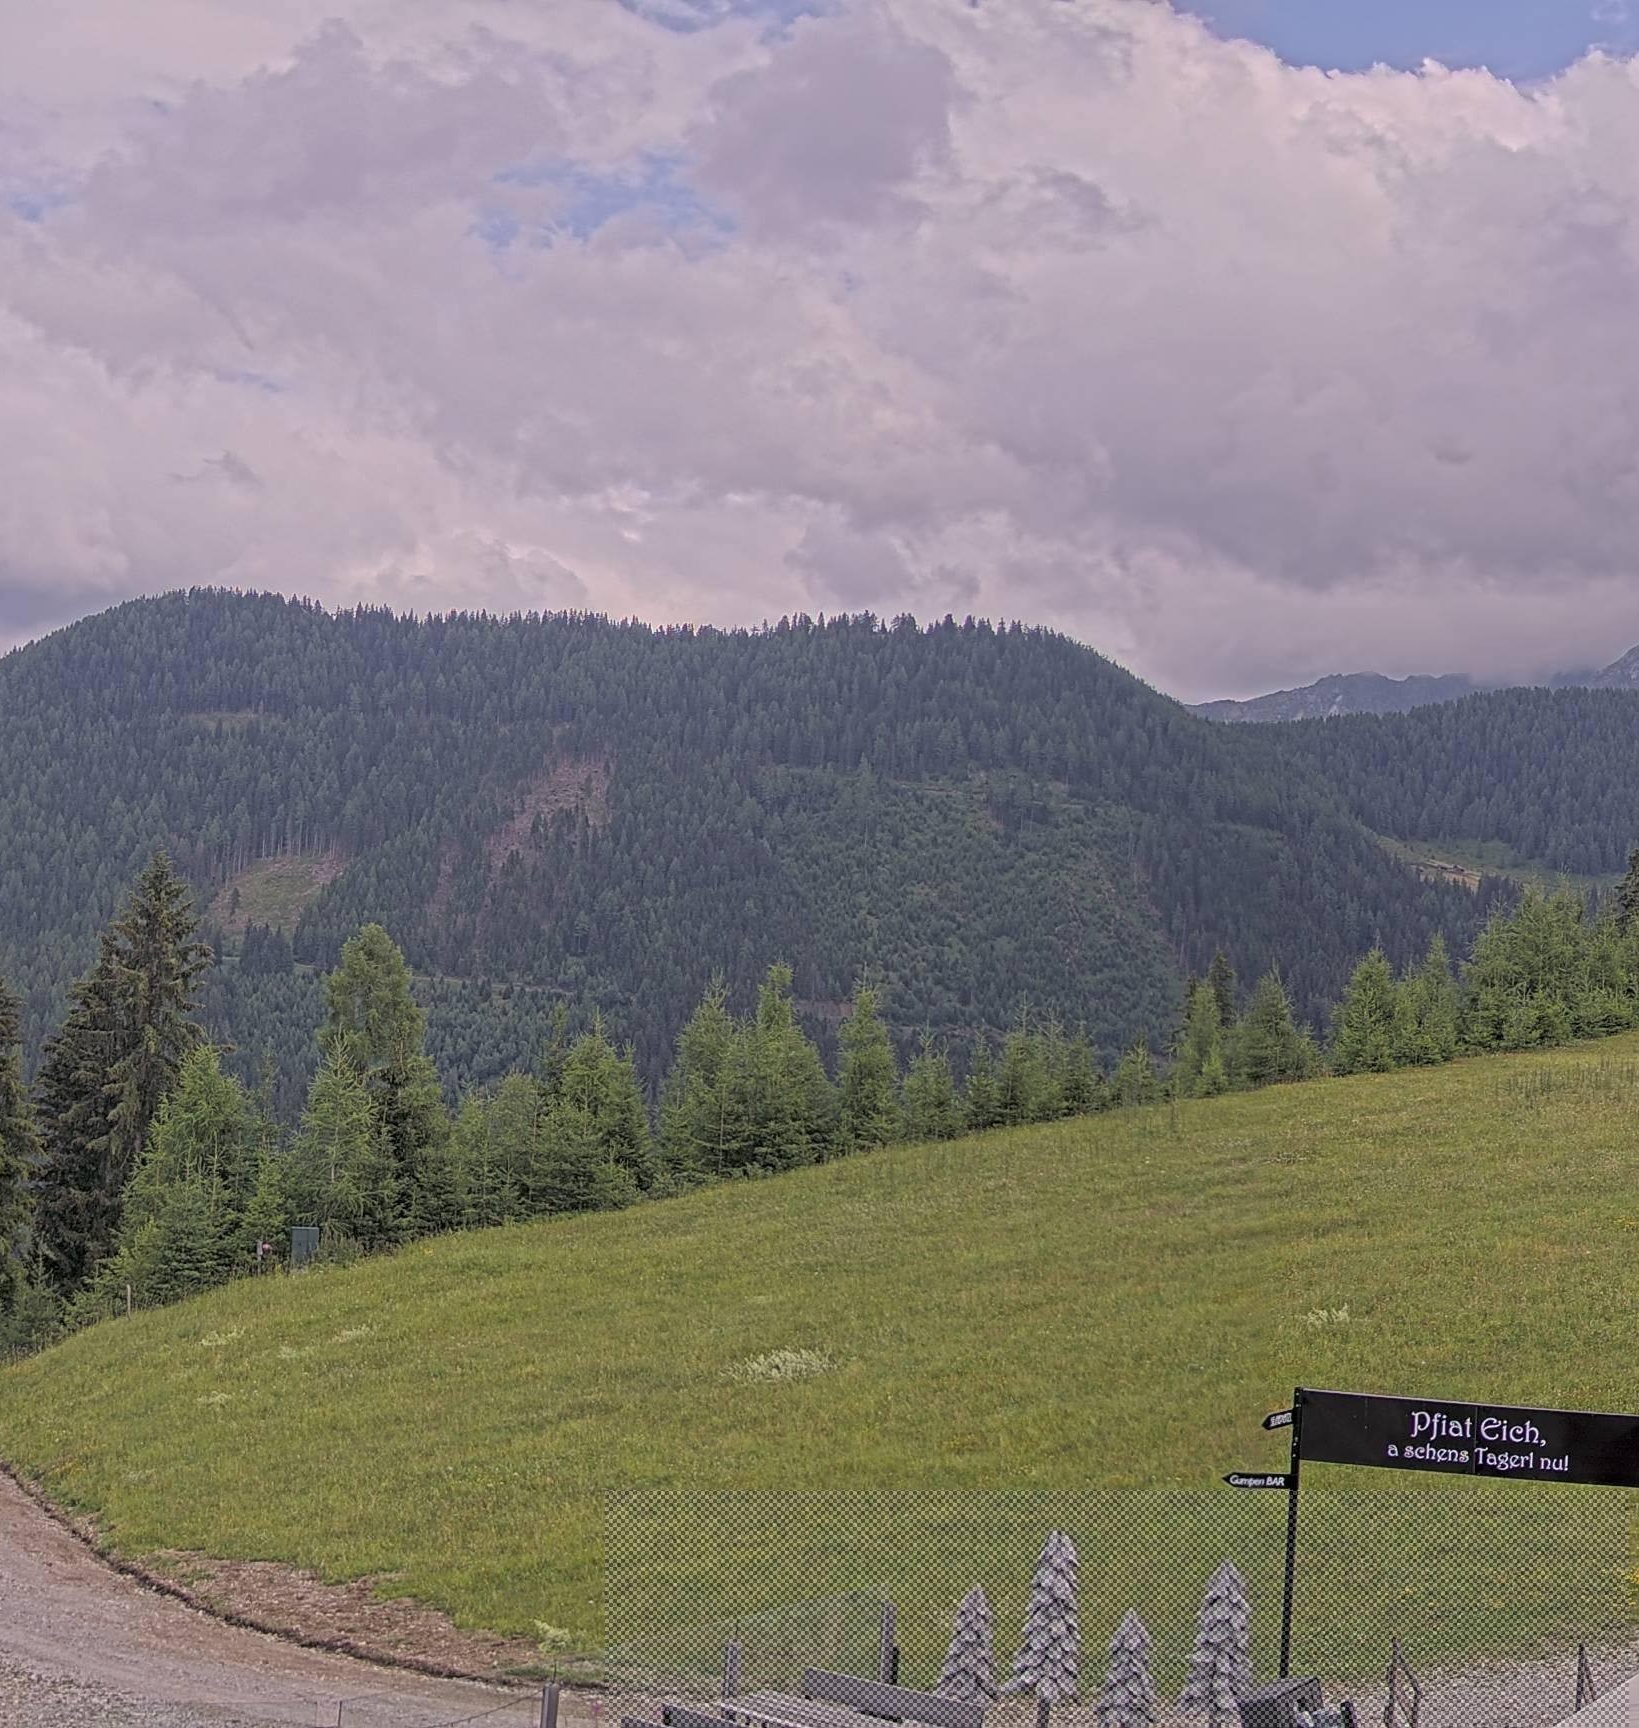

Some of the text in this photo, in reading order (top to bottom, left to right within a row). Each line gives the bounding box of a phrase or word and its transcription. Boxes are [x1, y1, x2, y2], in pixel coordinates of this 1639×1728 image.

[1410, 1411, 1547, 1447] Pfiat Eich,
[1387, 1444, 1569, 1471] a schens Tagerl nu!
[1266, 1476, 1285, 1486] BAR
